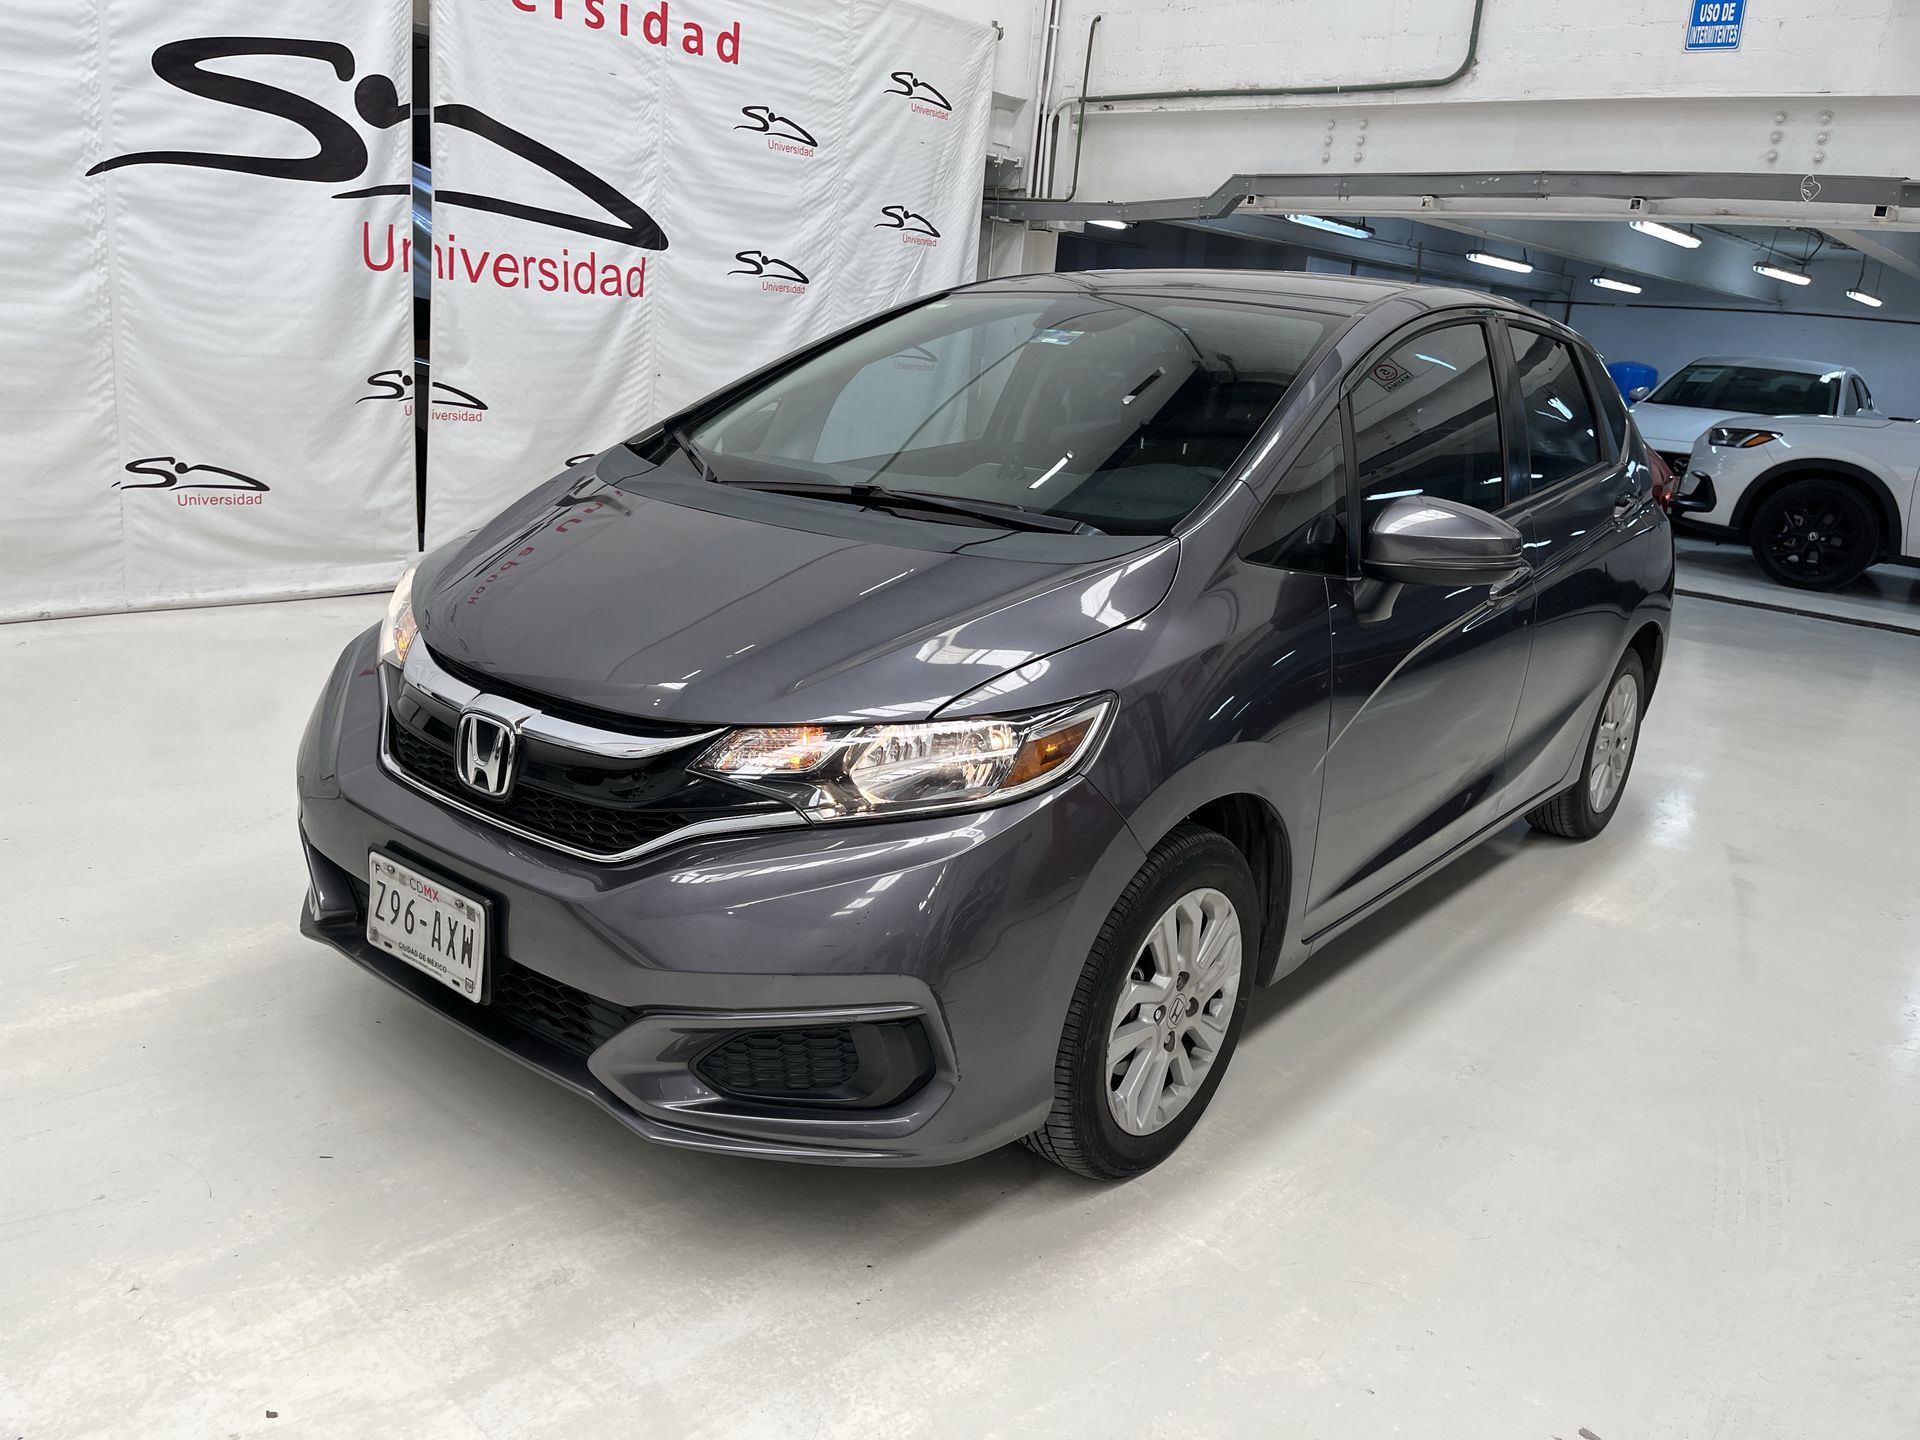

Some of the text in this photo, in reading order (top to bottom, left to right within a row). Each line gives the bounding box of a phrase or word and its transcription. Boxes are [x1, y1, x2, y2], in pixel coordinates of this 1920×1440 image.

[1700, 3, 1736, 22] USO DE
[1689, 25, 1739, 44] INTERMITENTES
[911, 102, 949, 120] Universidad
[767, 139, 814, 157] Universidad
[364, 221, 646, 298] Universidad
[762, 281, 806, 294] Universidad
[404, 404, 482, 422] Uiversidad
[177, 493, 263, 507] Universidad
[409, 877, 440, 902] CDMX
[375, 880, 474, 969] Z96-AXW
[398, 941, 419, 957] CIUDAD
[418, 952, 427, 962] DE
